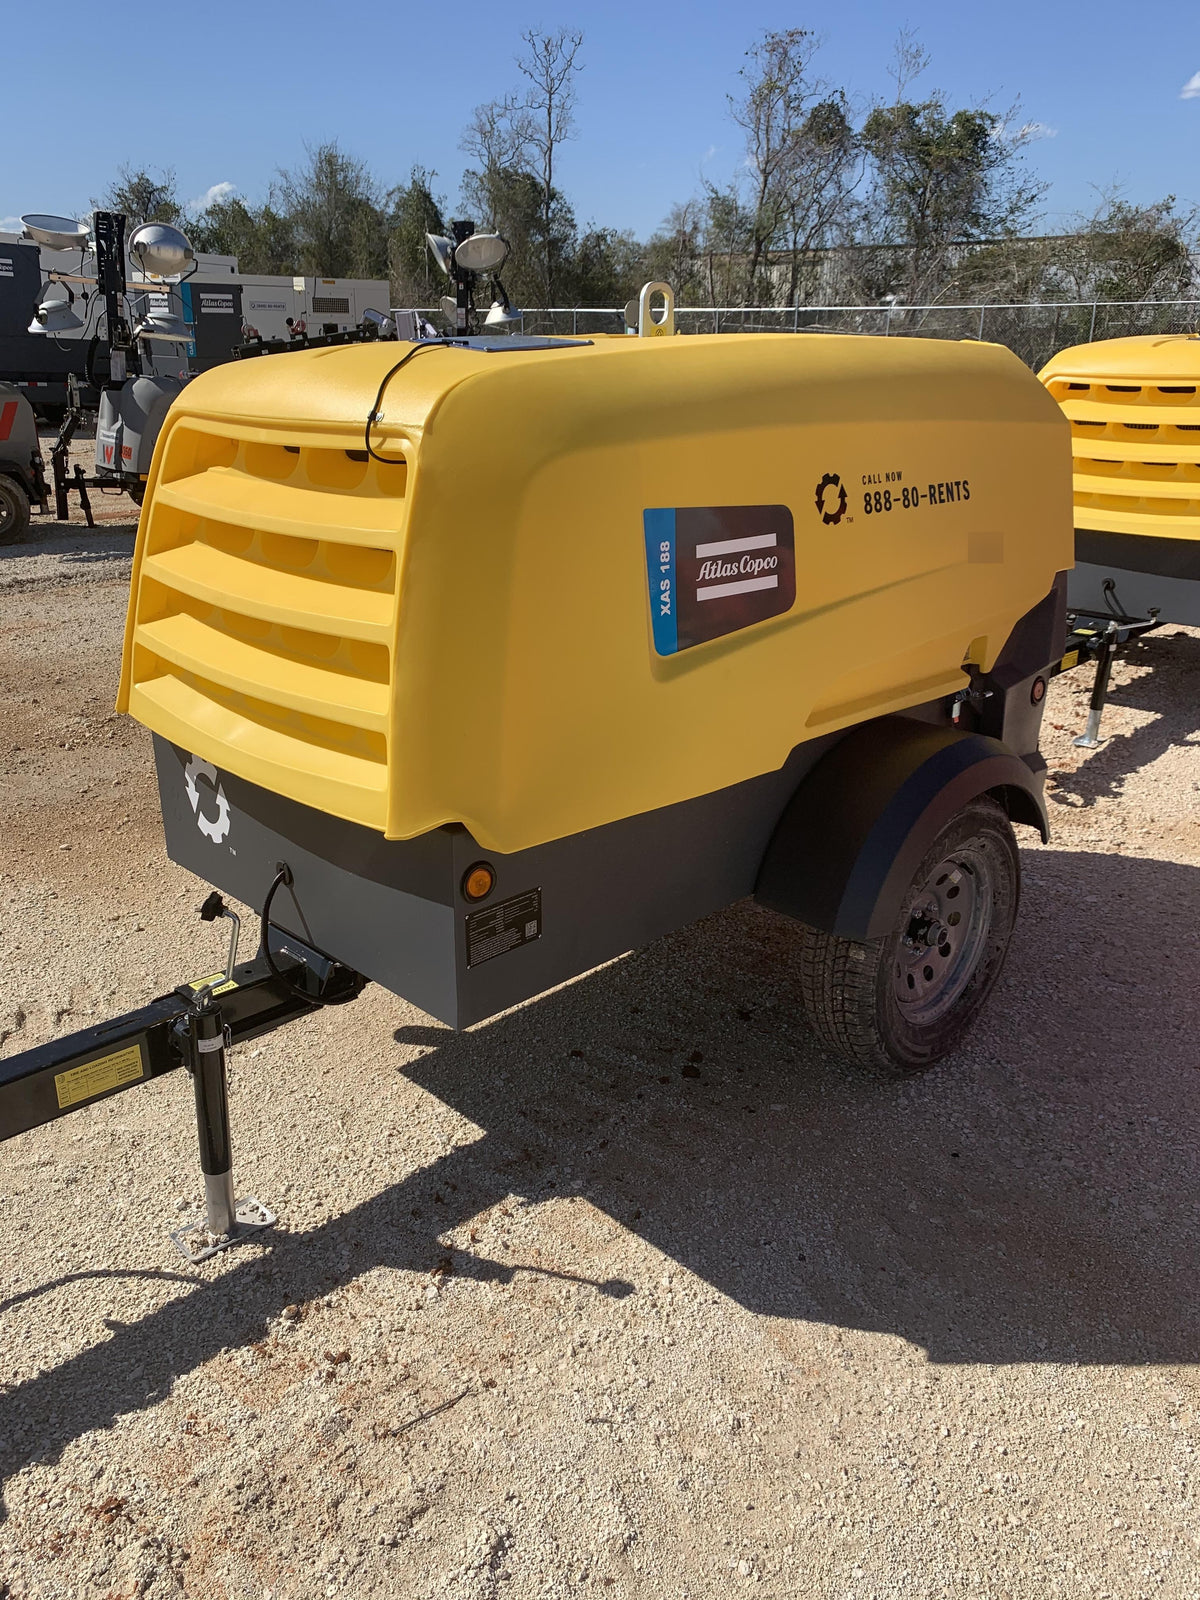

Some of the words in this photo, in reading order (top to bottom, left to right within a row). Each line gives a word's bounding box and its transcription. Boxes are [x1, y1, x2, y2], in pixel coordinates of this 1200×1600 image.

[861, 473, 883, 486] CALL
[885, 471, 903, 483] NOW
[863, 480, 971, 515] 888-80-RENTS
[659, 540, 671, 575] 188
[659, 580, 671, 616] XAS
